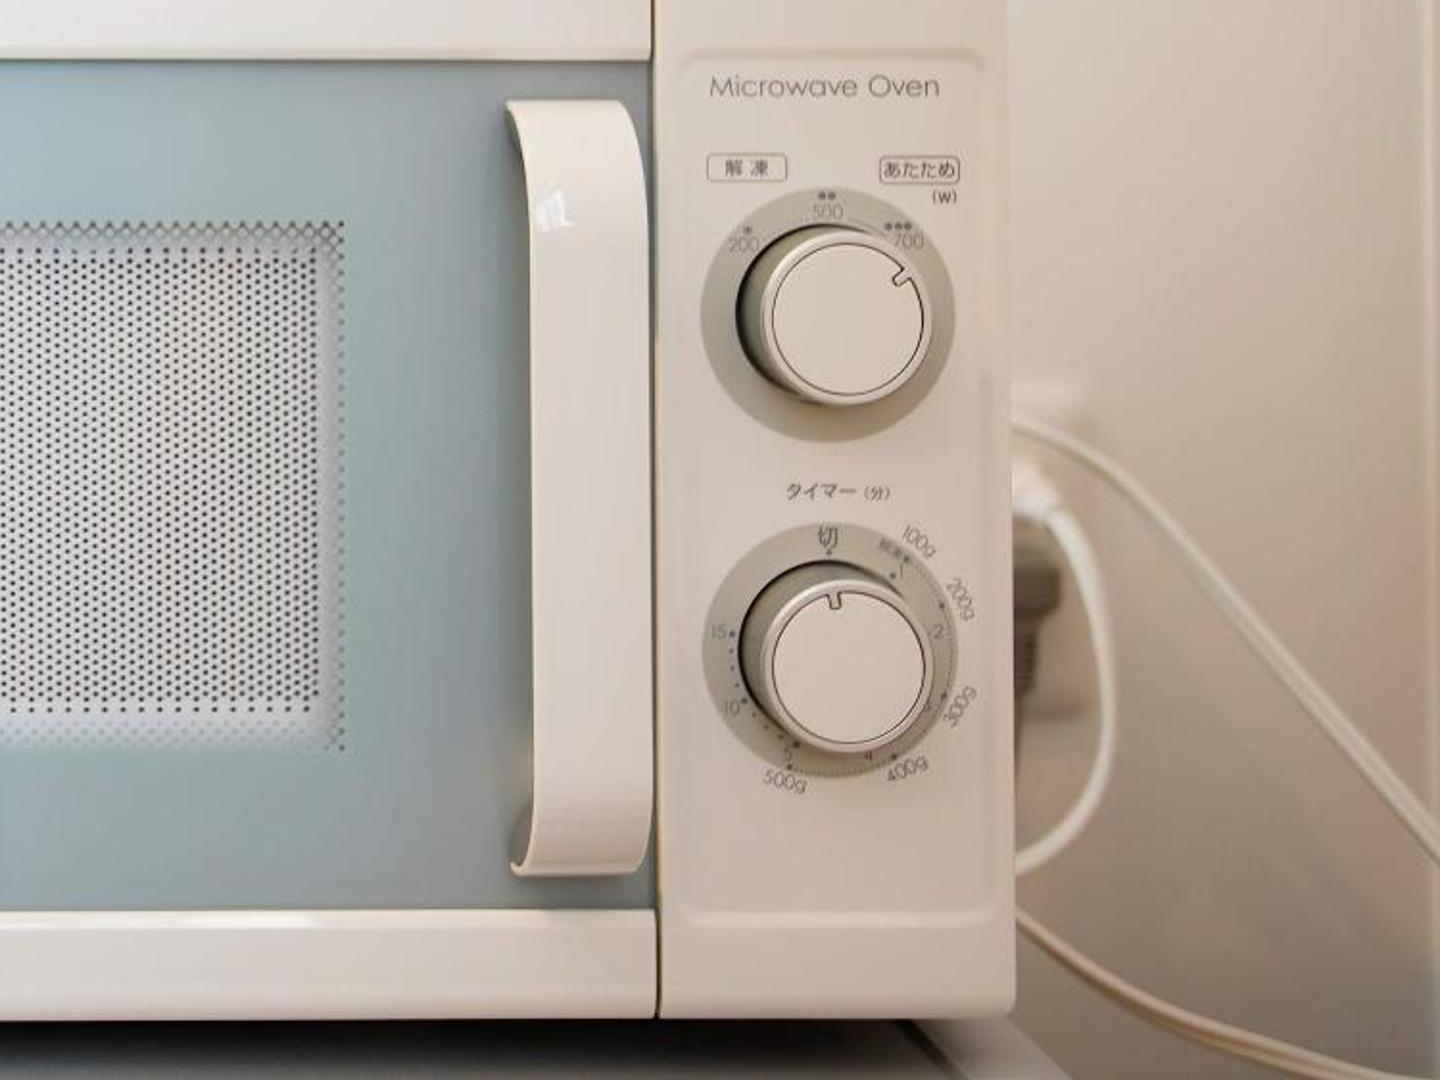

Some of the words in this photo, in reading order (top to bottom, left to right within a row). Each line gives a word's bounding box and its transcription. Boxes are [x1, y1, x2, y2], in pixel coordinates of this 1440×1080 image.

[709, 74, 858, 98] Microwave
[868, 74, 940, 98] Oven
[884, 161, 955, 179] あたため
[932, 190, 957, 205] (W)
[812, 203, 843, 219] 500
[728, 237, 759, 253] 200
[894, 233, 924, 250] 700
[786, 483, 857, 500] タイマー
[817, 525, 839, 549] 切
[902, 524, 936, 559] 100g
[946, 577, 975, 621] 200g
[711, 624, 727, 639] 15
[724, 699, 741, 716] 10
[886, 754, 929, 782] 400g
[762, 769, 808, 794] 500g
